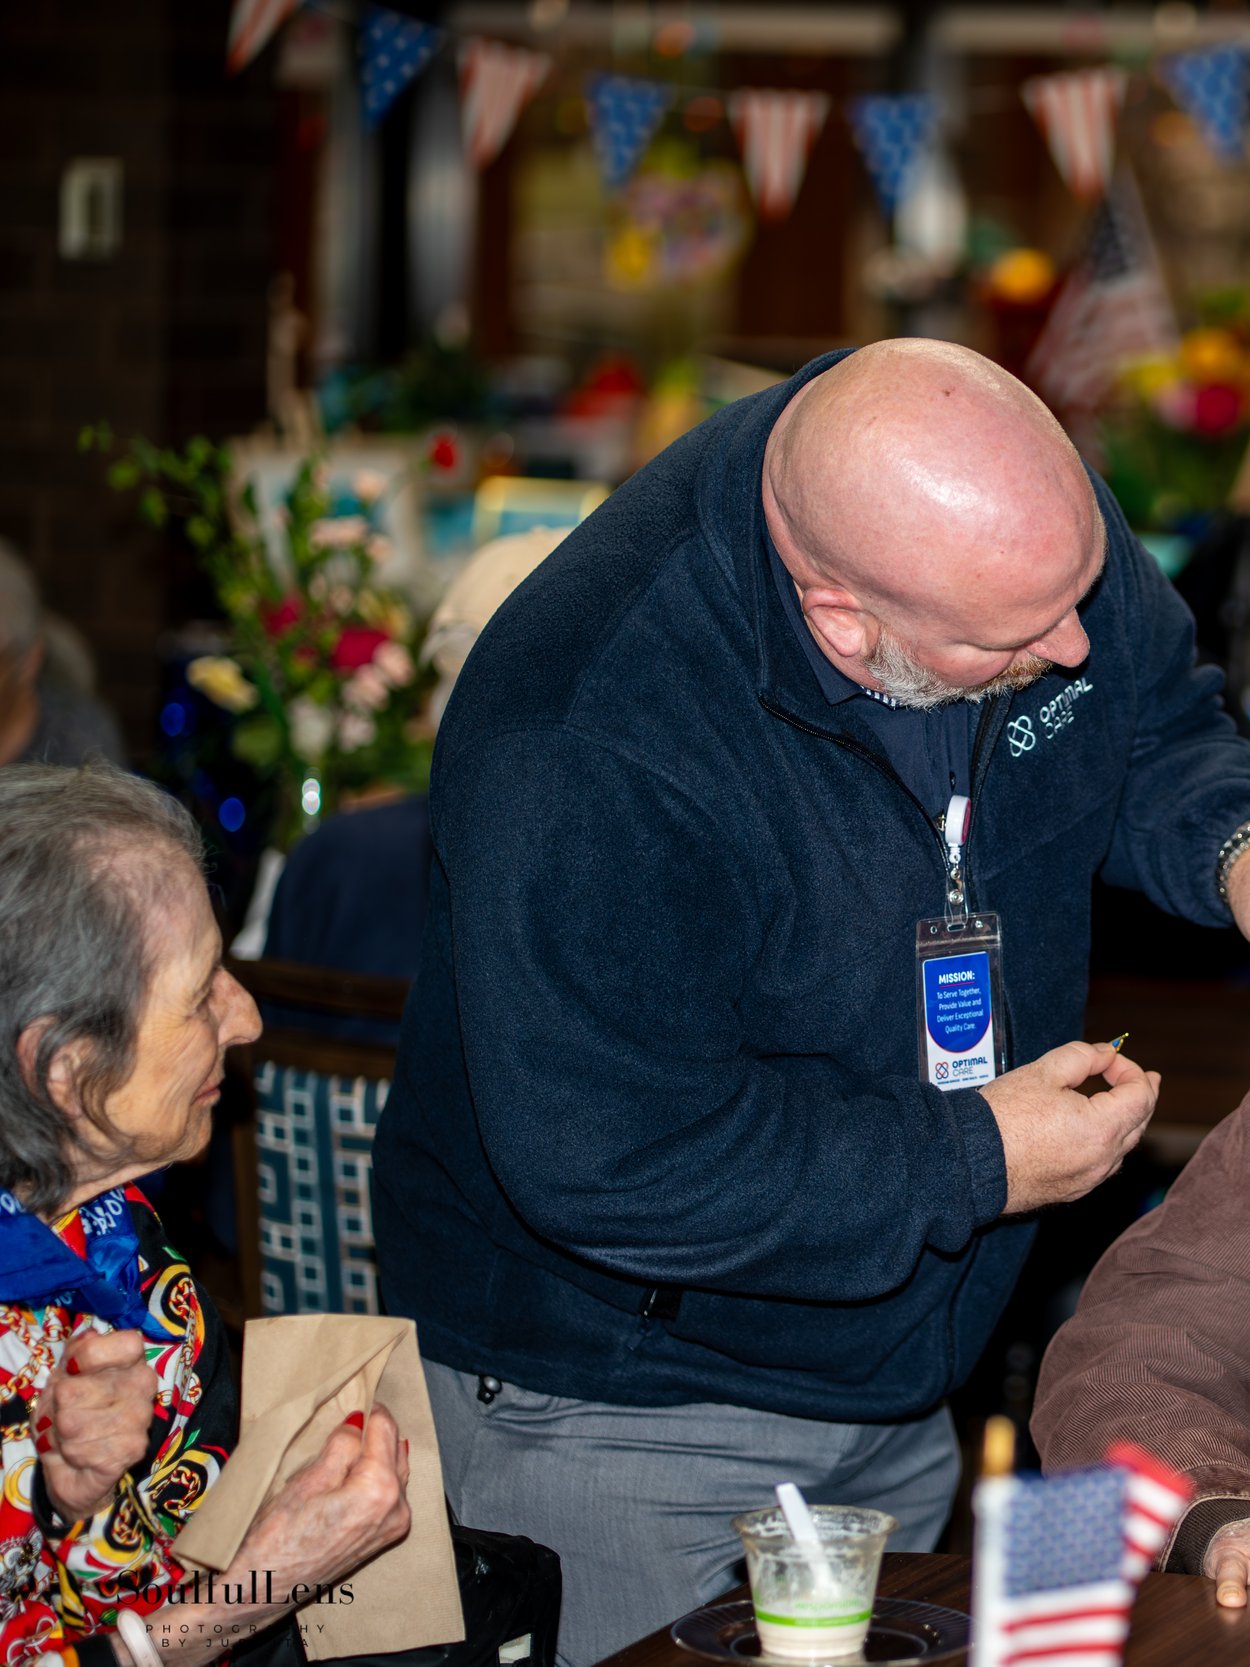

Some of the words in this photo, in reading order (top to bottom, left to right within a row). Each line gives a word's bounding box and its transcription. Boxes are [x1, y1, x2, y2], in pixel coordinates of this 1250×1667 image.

[1040, 677, 1093, 723] OPTIMAL
[938, 970, 976, 984] MISSION:
[944, 990, 958, 998] Serve
[939, 1002, 957, 1010] Provide
[958, 1000, 971, 1008] Value
[972, 998, 982, 1006] and
[937, 1013, 954, 1023] Deliver
[955, 1009, 984, 1020] Exceptional
[945, 1024, 963, 1034] Quality
[952, 1056, 988, 1068] OPTIMAL
[952, 1066, 974, 1077] CARE
